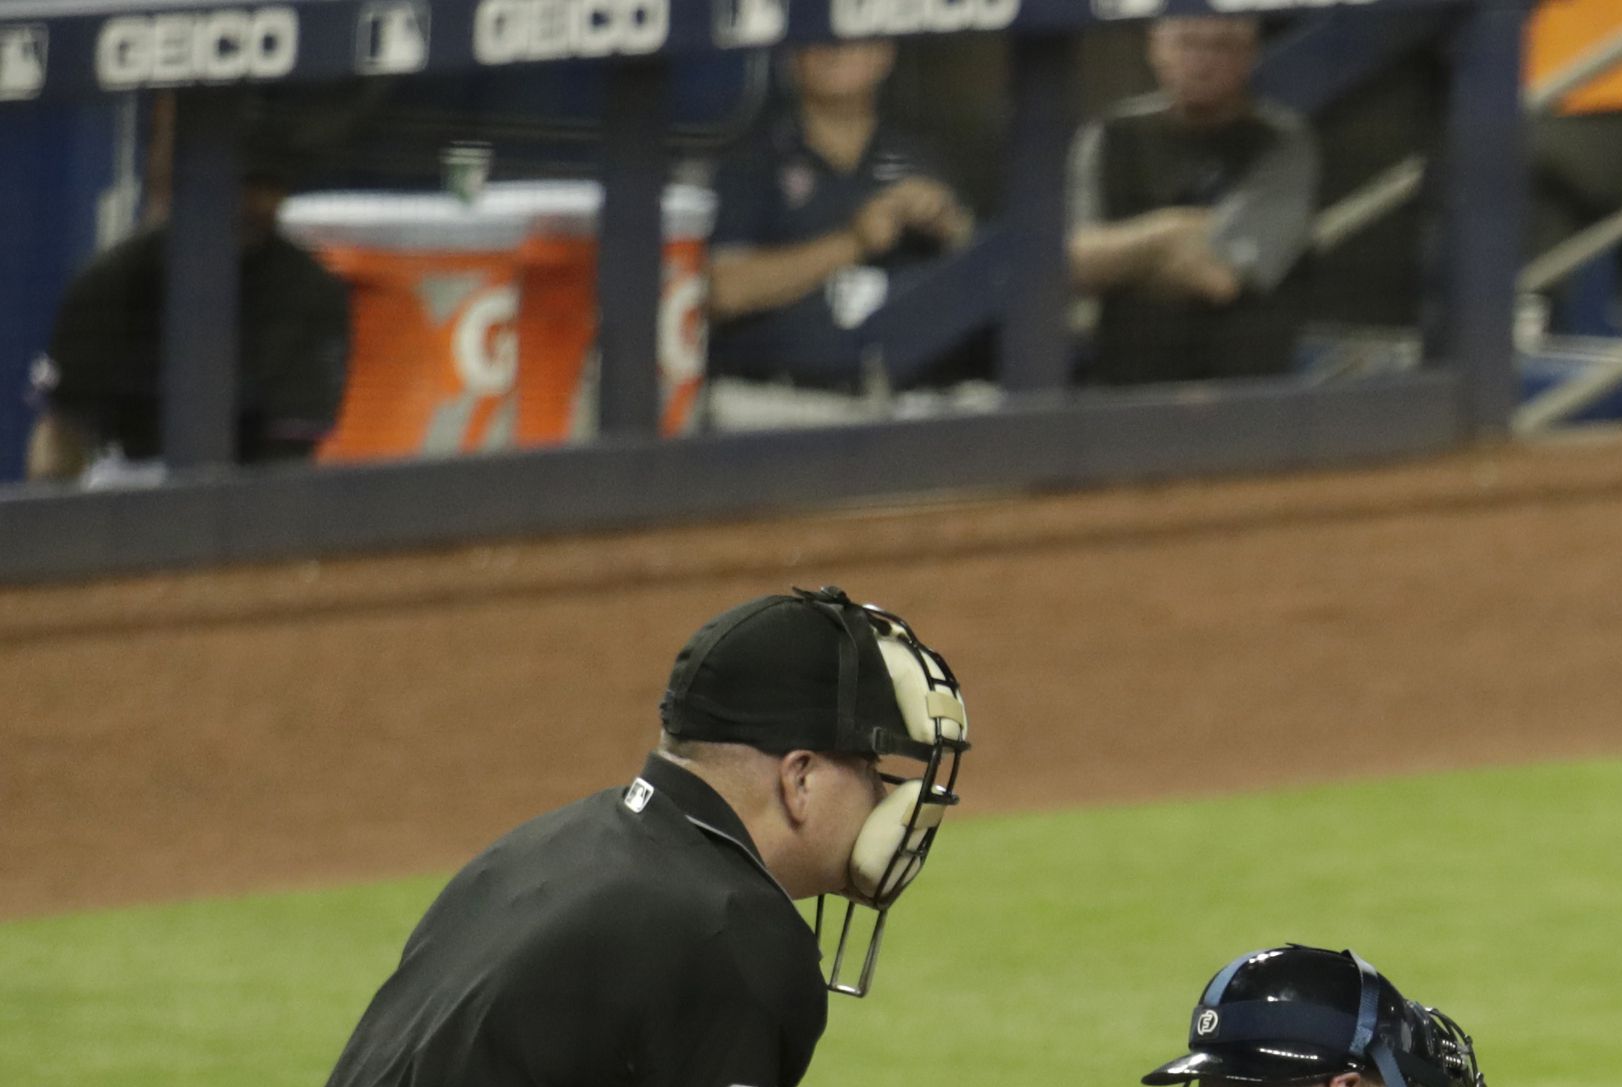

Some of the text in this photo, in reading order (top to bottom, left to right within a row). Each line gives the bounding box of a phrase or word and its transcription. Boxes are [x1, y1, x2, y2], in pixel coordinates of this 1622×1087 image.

[96, 9, 299, 91] GEICO
[472, 0, 670, 65] GEICO
[453, 285, 519, 396] G
